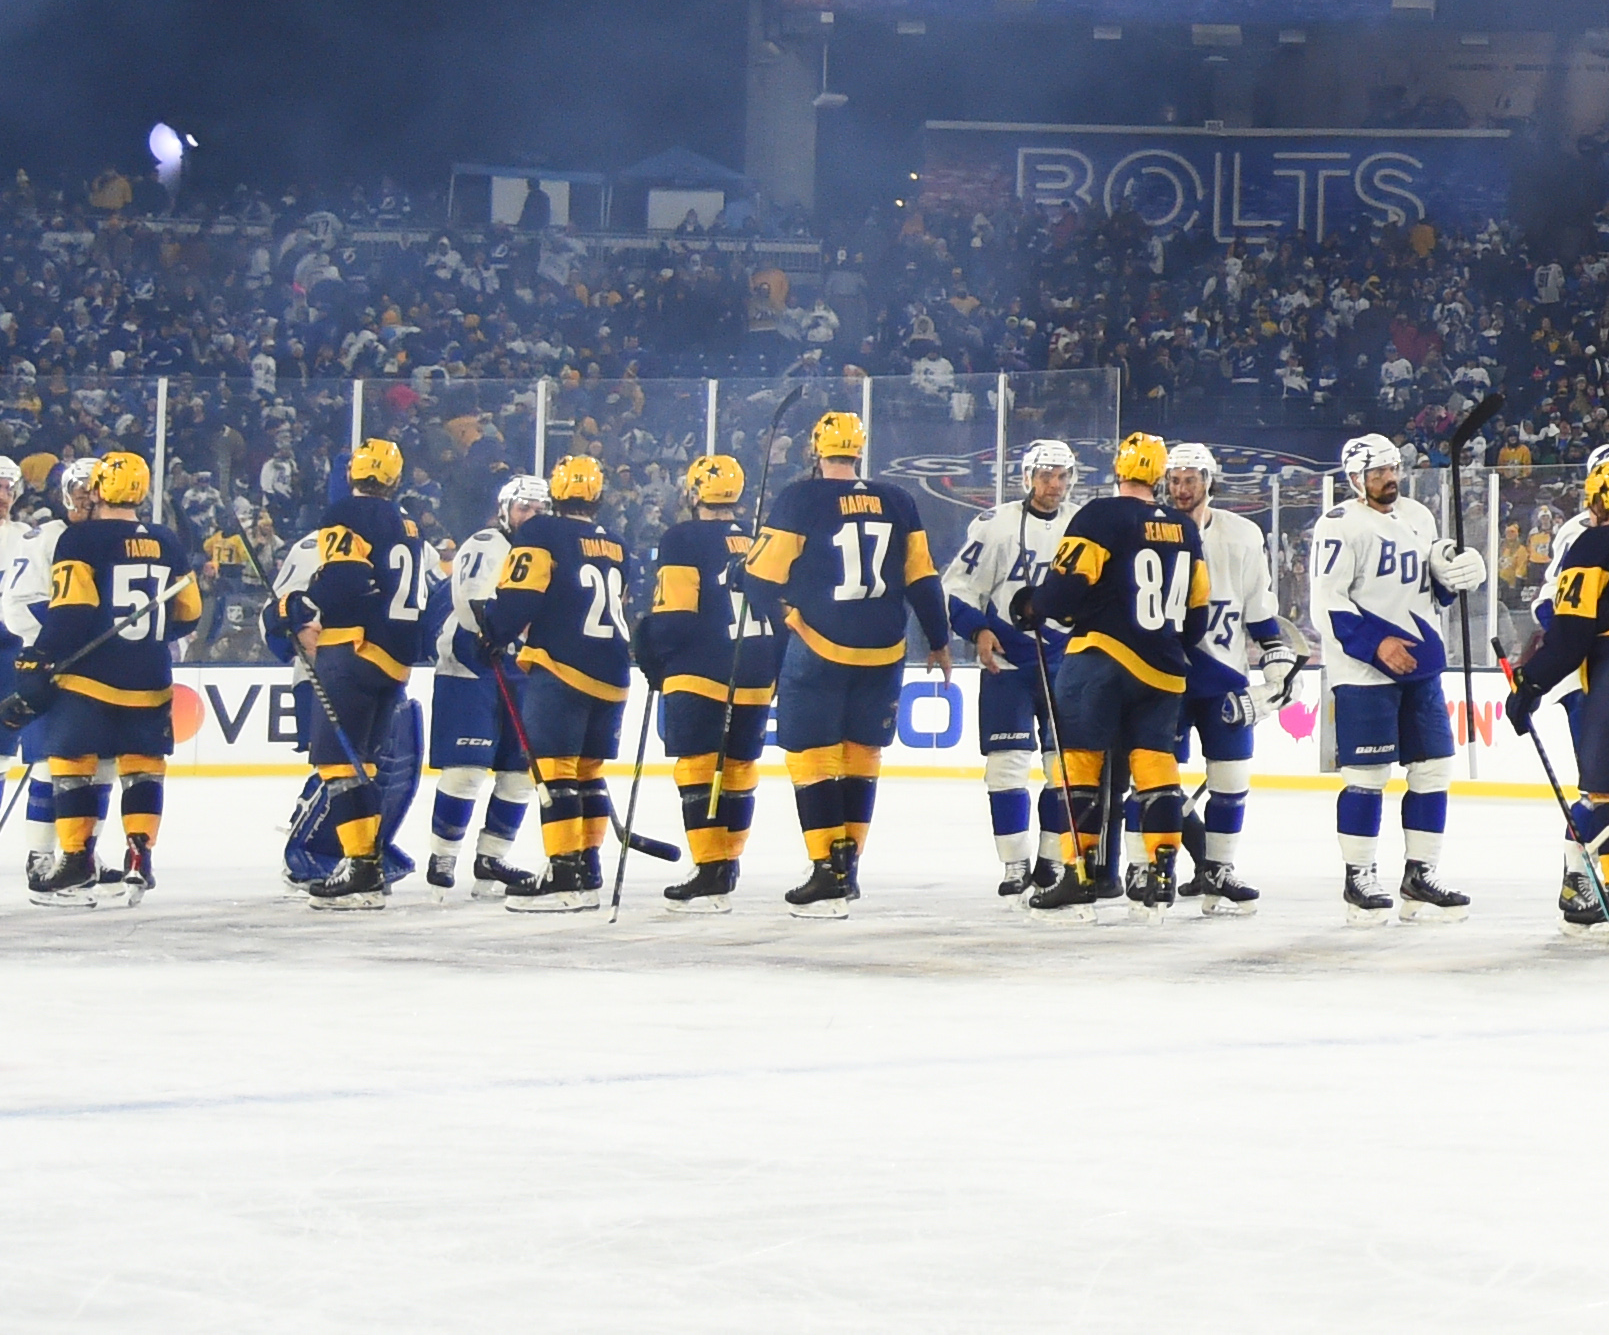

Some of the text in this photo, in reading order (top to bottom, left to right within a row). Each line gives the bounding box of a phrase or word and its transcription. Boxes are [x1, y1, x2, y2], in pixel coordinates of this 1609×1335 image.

[1016, 146, 1426, 244] BOLTS
[839, 495, 883, 516] HARPUR
[325, 530, 354, 562] 24
[832, 521, 893, 602] 17
[1314, 538, 1343, 578] 17
[459, 551, 484, 586] 21
[112, 563, 172, 642] 57
[1134, 548, 1191, 633] 84
[1554, 571, 1585, 610] 64
